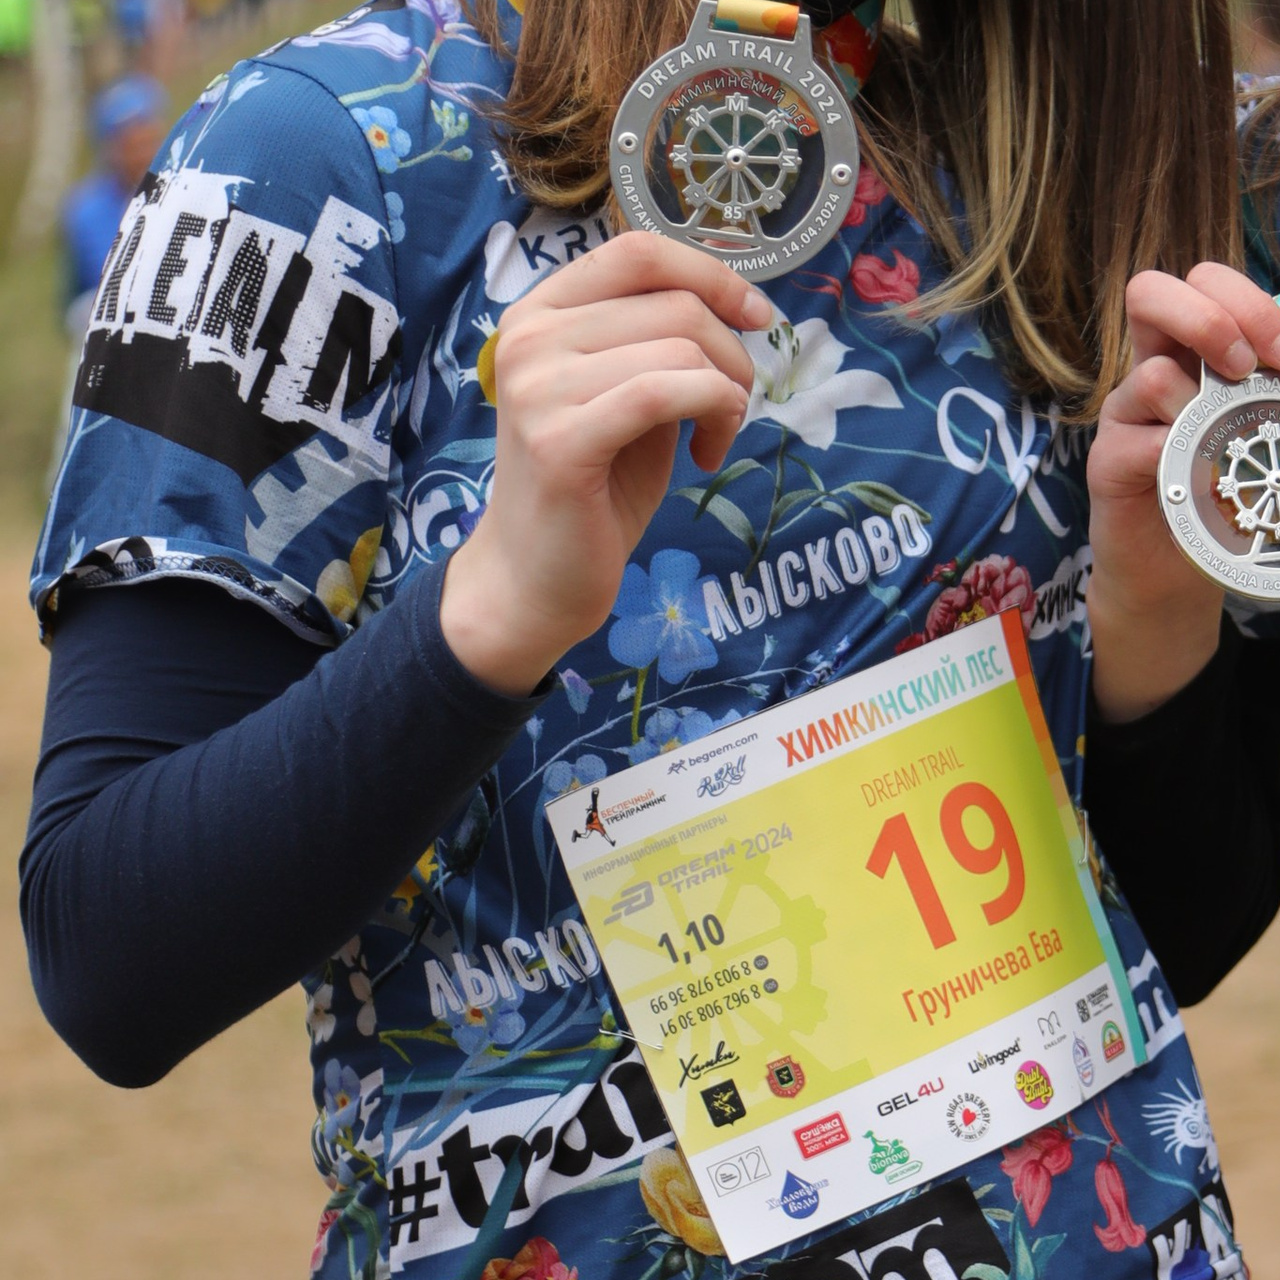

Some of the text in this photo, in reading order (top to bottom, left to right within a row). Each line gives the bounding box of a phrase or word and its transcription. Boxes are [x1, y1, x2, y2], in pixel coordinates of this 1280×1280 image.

[638, 40, 842, 125] DREAM TRAIL 2024
[668, 75, 811, 137] ХИМКИНСКИЙ ЛЕС
[618, 164, 668, 243] СПАРТАКИ
[781, 192, 841, 259] 14.04.2024
[723, 205, 743, 220] 85
[1171, 386, 1234, 452] DREAM
[1175, 513, 1258, 588] СПАРТАКИАДА
[700, 503, 933, 643] ЛЫСКОВО
[777, 645, 1004, 768] ХИМКИНСКИЙ ЛЕС
[688, 732, 759, 767] begaem.com
[861, 746, 965, 809] DREAM TRAIL
[601, 788, 655, 818] БЕСПЕЧНЫЙ
[582, 814, 728, 882] ИНФОРМАЦИОННЫЕ ПАРТНЕРЫ
[741, 822, 794, 860] 2024
[657, 843, 736, 887] DREAM
[671, 862, 734, 894] TRAIL
[864, 781, 1025, 950] 19
[658, 914, 725, 966] 1,10
[424, 918, 601, 1019] ЛЫСКО
[714, 965, 741, 983] 903
[741, 961, 751, 976] 8
[901, 928, 1064, 1026] Груничева Ева
[668, 987, 687, 1007] 36
[687, 976, 714, 998] 978
[723, 989, 750, 1010] 962
[750, 984, 761, 999] 8
[650, 998, 668, 1014] 99
[678, 1011, 697, 1030] 30
[697, 1000, 723, 1022] 908
[660, 1021, 678, 1037] 91
[967, 1039, 1021, 1074] Livingood
[1015, 1065, 1043, 1090] Dubl
[877, 1077, 945, 1117] GEL4U
[946, 1093, 964, 1120] RIGAS
[964, 1093, 991, 1125] BREWERY
[946, 1120, 962, 1139] NEW
[870, 1149, 910, 1171] bionova
